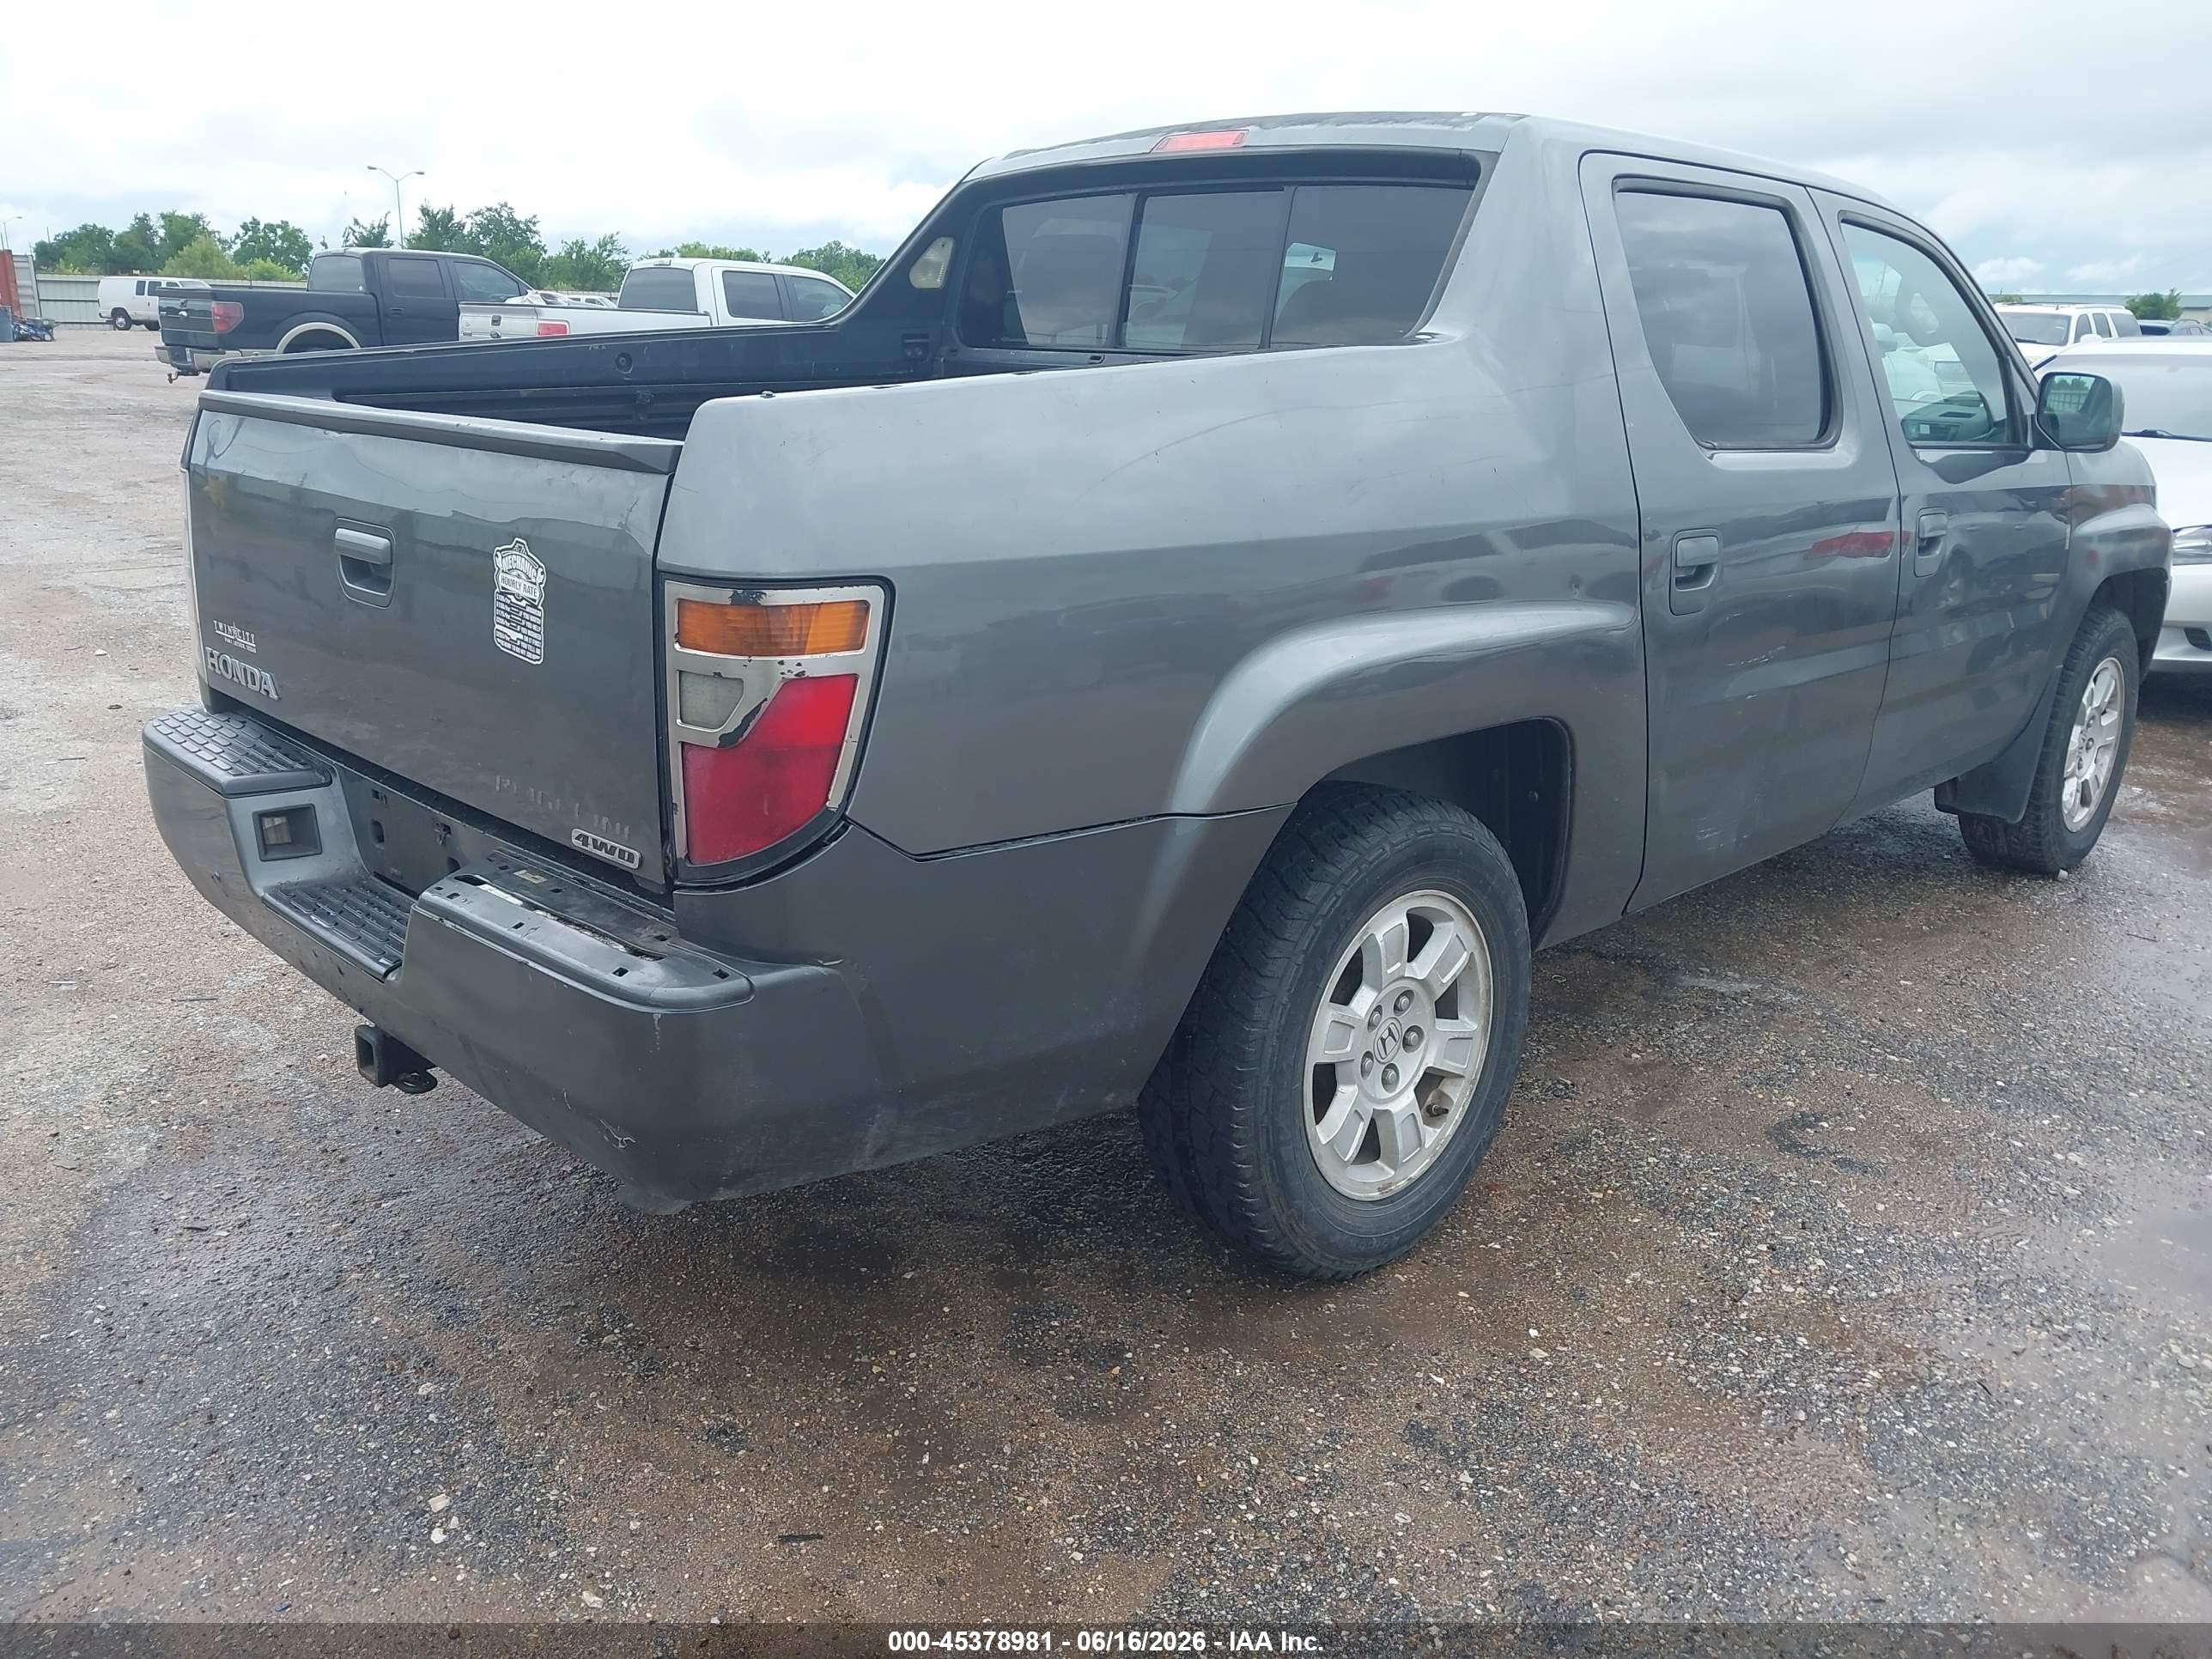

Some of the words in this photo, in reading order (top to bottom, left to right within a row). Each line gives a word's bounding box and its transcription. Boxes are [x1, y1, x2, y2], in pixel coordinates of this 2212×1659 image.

[501, 554, 537, 583] MECHANIC
[501, 574, 522, 591] HOURLY
[523, 583, 538, 599] RATE
[213, 619, 233, 636] TWIN
[237, 629, 255, 644] CITY
[206, 647, 280, 701] HONDA
[574, 833, 635, 864] 4WD
